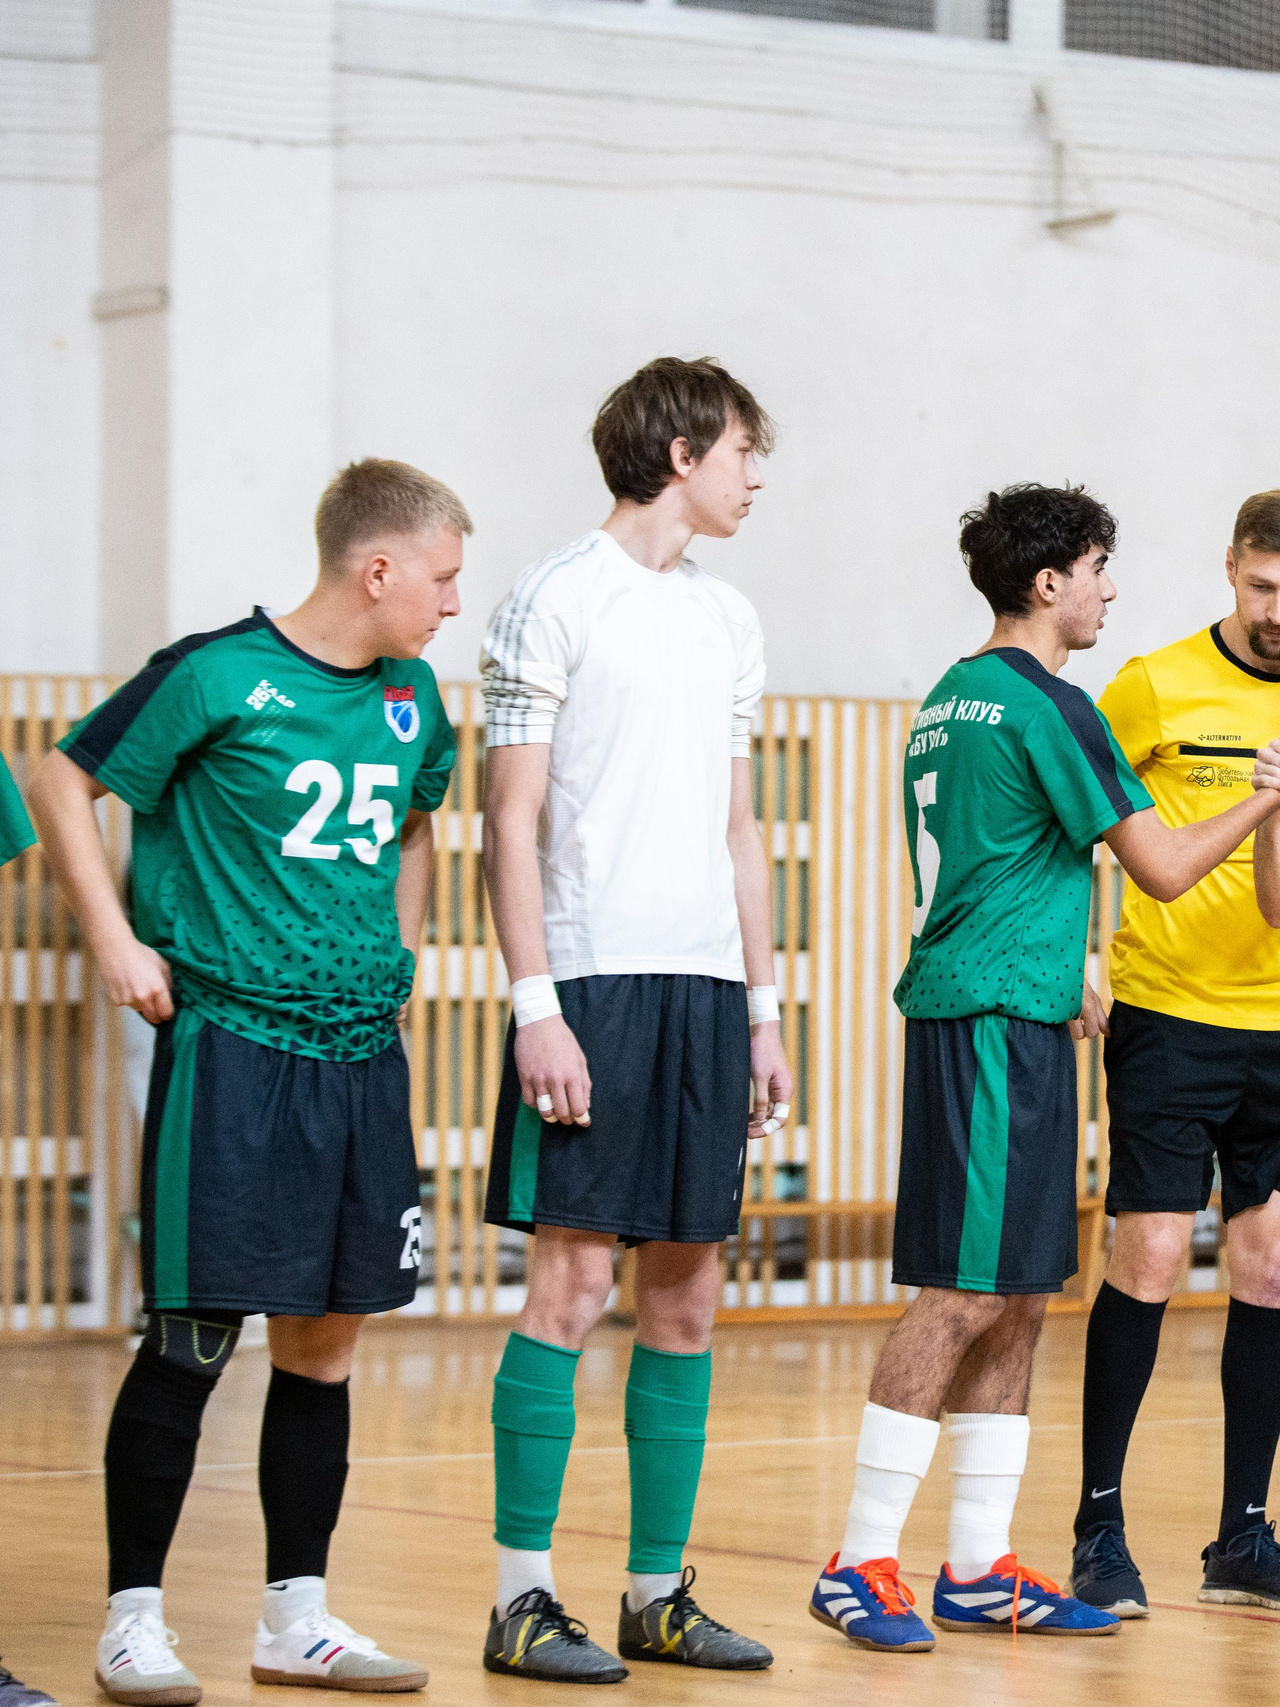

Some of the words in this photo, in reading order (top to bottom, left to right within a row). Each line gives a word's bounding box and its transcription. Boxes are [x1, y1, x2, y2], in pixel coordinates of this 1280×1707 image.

[954, 699, 1005, 725] КЛУБ
[1206, 734, 1242, 742] ALTERNATIVA
[281, 759, 399, 865] 25
[911, 771, 941, 938] 5
